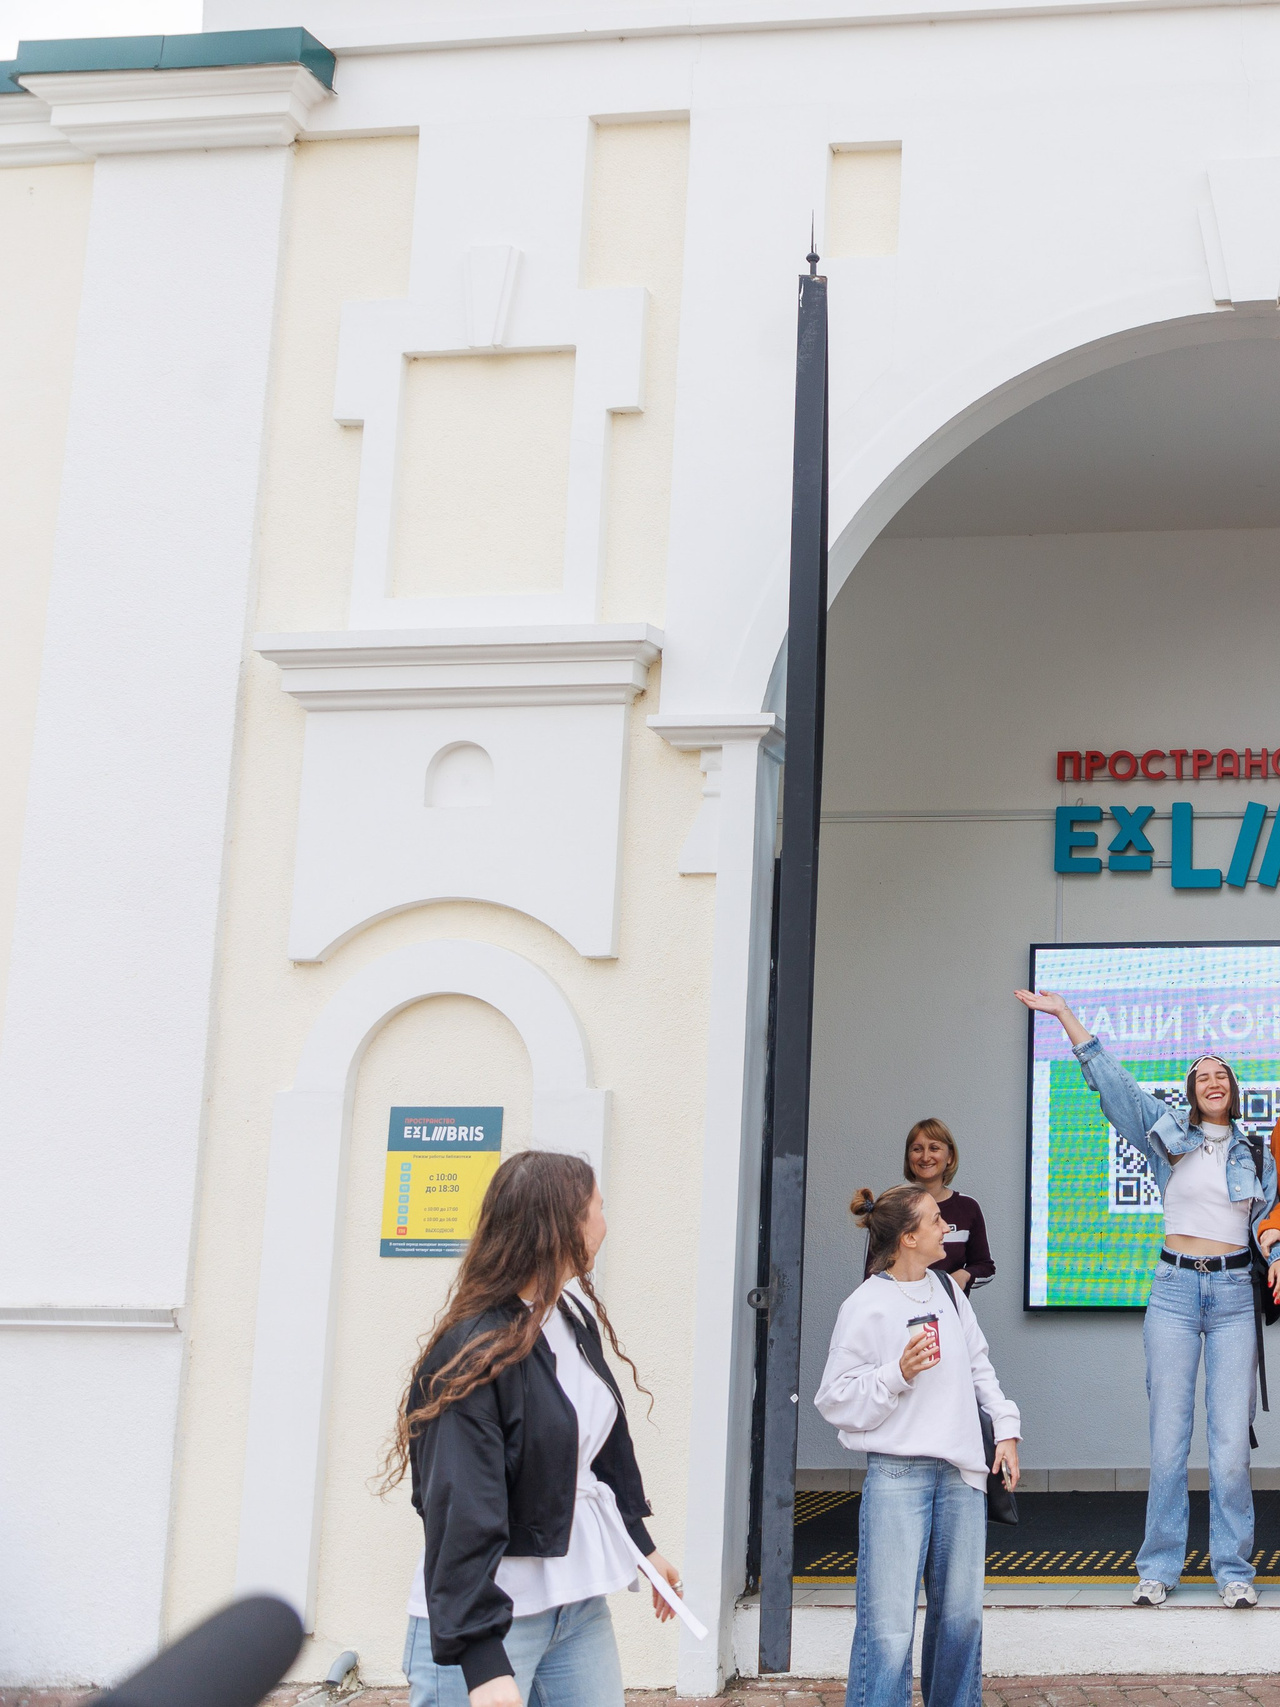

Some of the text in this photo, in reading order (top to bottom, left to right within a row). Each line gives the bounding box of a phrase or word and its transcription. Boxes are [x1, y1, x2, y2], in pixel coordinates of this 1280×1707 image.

[404, 1117, 456, 1125] ПРОСТРАНСТВО
[435, 1173, 458, 1181] 10:00
[425, 1184, 460, 1193] до 18:30
